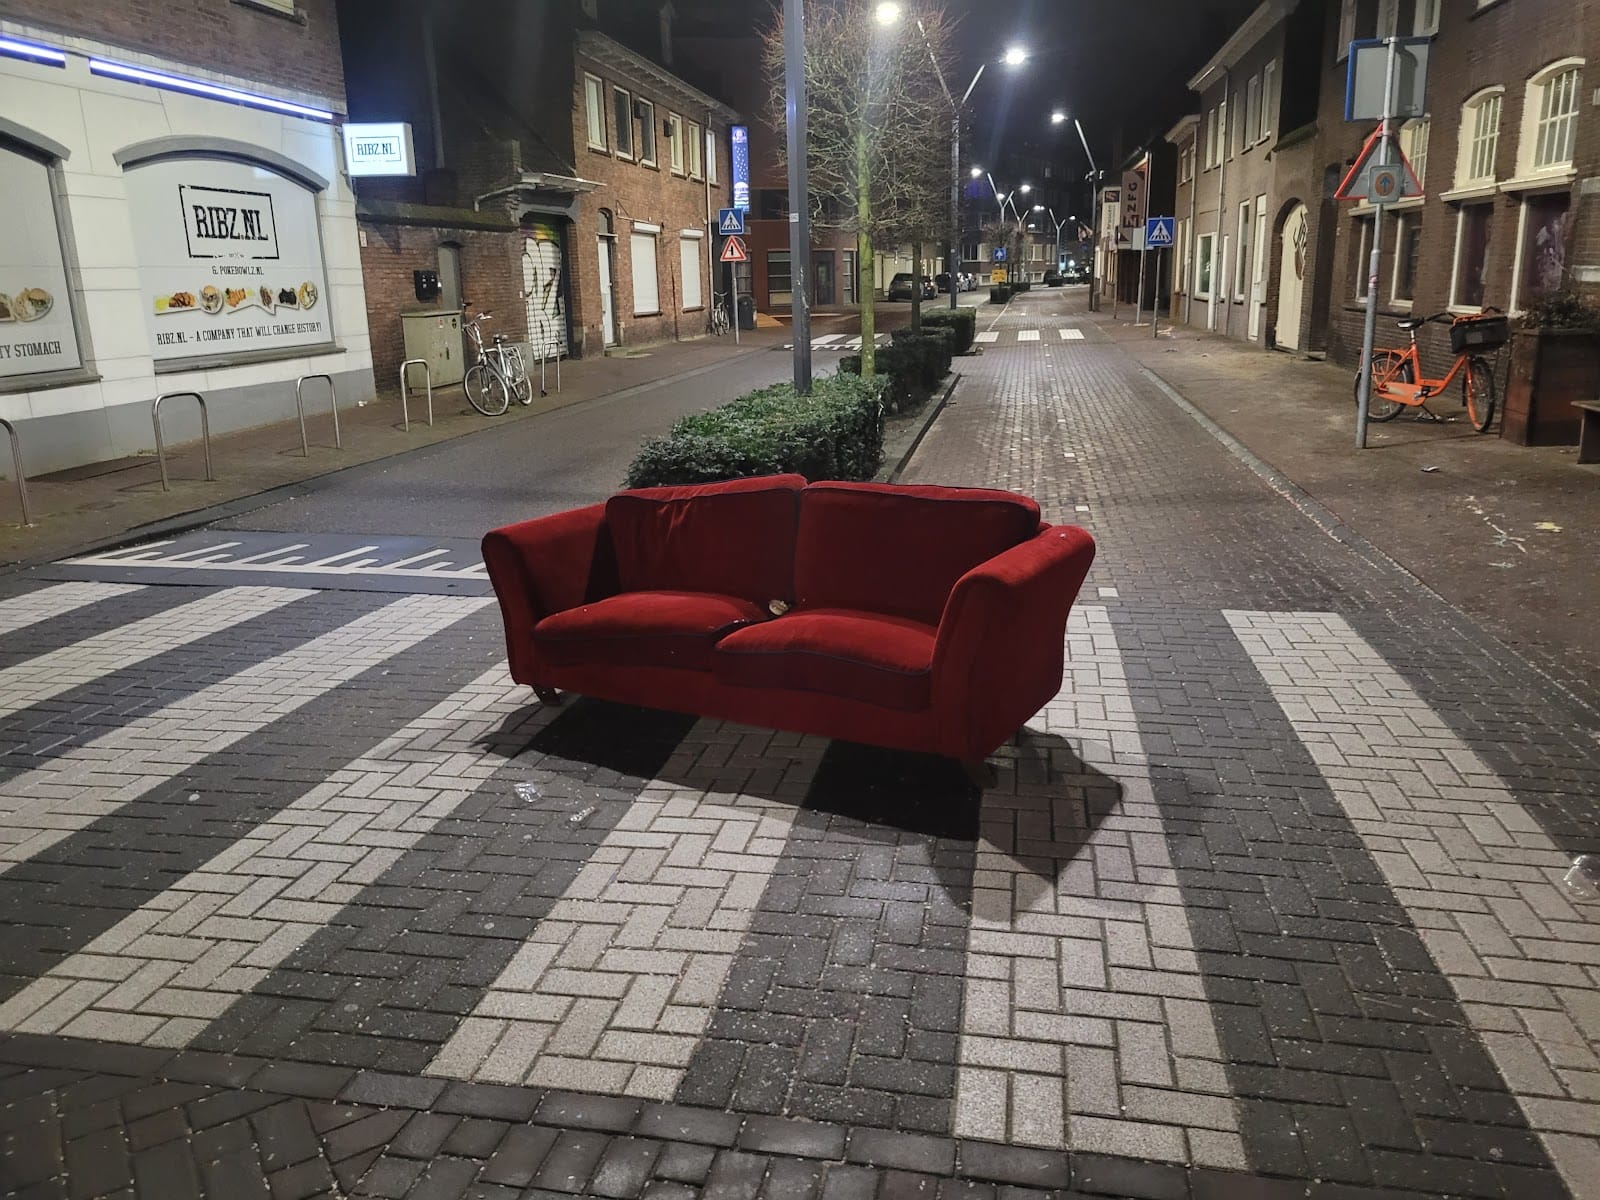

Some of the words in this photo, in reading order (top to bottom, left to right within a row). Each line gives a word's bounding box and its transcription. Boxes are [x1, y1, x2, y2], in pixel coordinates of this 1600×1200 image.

[356, 143, 396, 156] RIBZ.NL
[192, 204, 269, 241] RIBZ.NL
[219, 265, 264, 275] POKEBOWLZ.NL
[156, 331, 188, 345] RIBZ.NL
[196, 331, 201, 342] A
[202, 328, 235, 342] COMPANY
[236, 327, 254, 338] THAT
[255, 325, 272, 337] WILL
[272, 323, 296, 335] CHANGE
[14, 340, 62, 358] STOMACH
